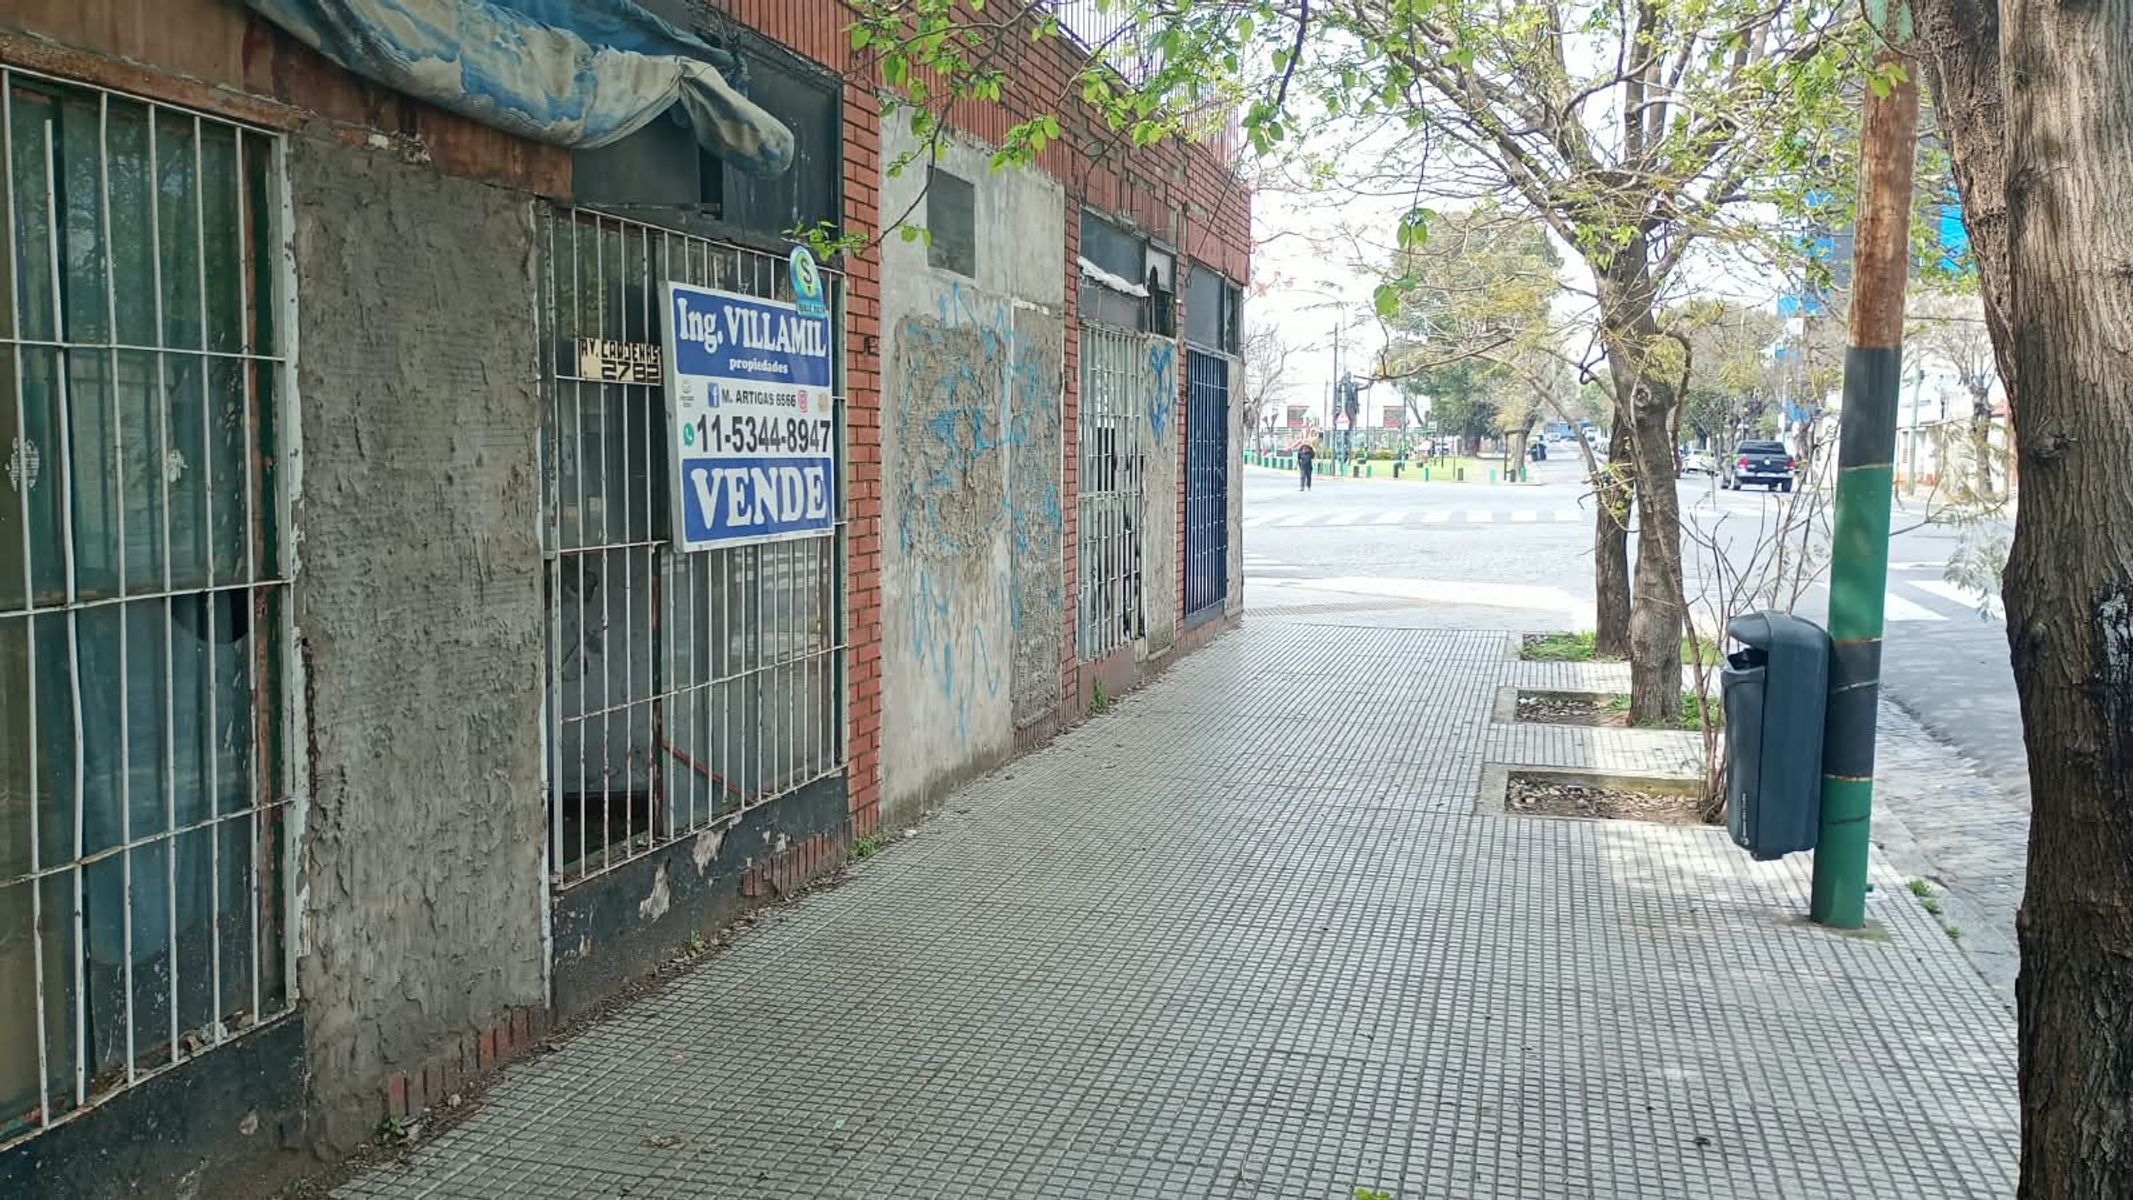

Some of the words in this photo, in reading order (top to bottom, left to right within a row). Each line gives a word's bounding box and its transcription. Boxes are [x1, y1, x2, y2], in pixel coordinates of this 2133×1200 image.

[677, 297, 724, 354] Ing.
[724, 305, 827, 357] VILLAMIL
[581, 339, 598, 358] AV.
[601, 340, 660, 364] CARDENAS
[729, 357, 789, 375] propiedades
[721, 388, 733, 405] M.
[735, 389, 775, 406] ARTIGAS
[697, 413, 832, 453] 11-5344-8947
[690, 466, 828, 531] VENDE
